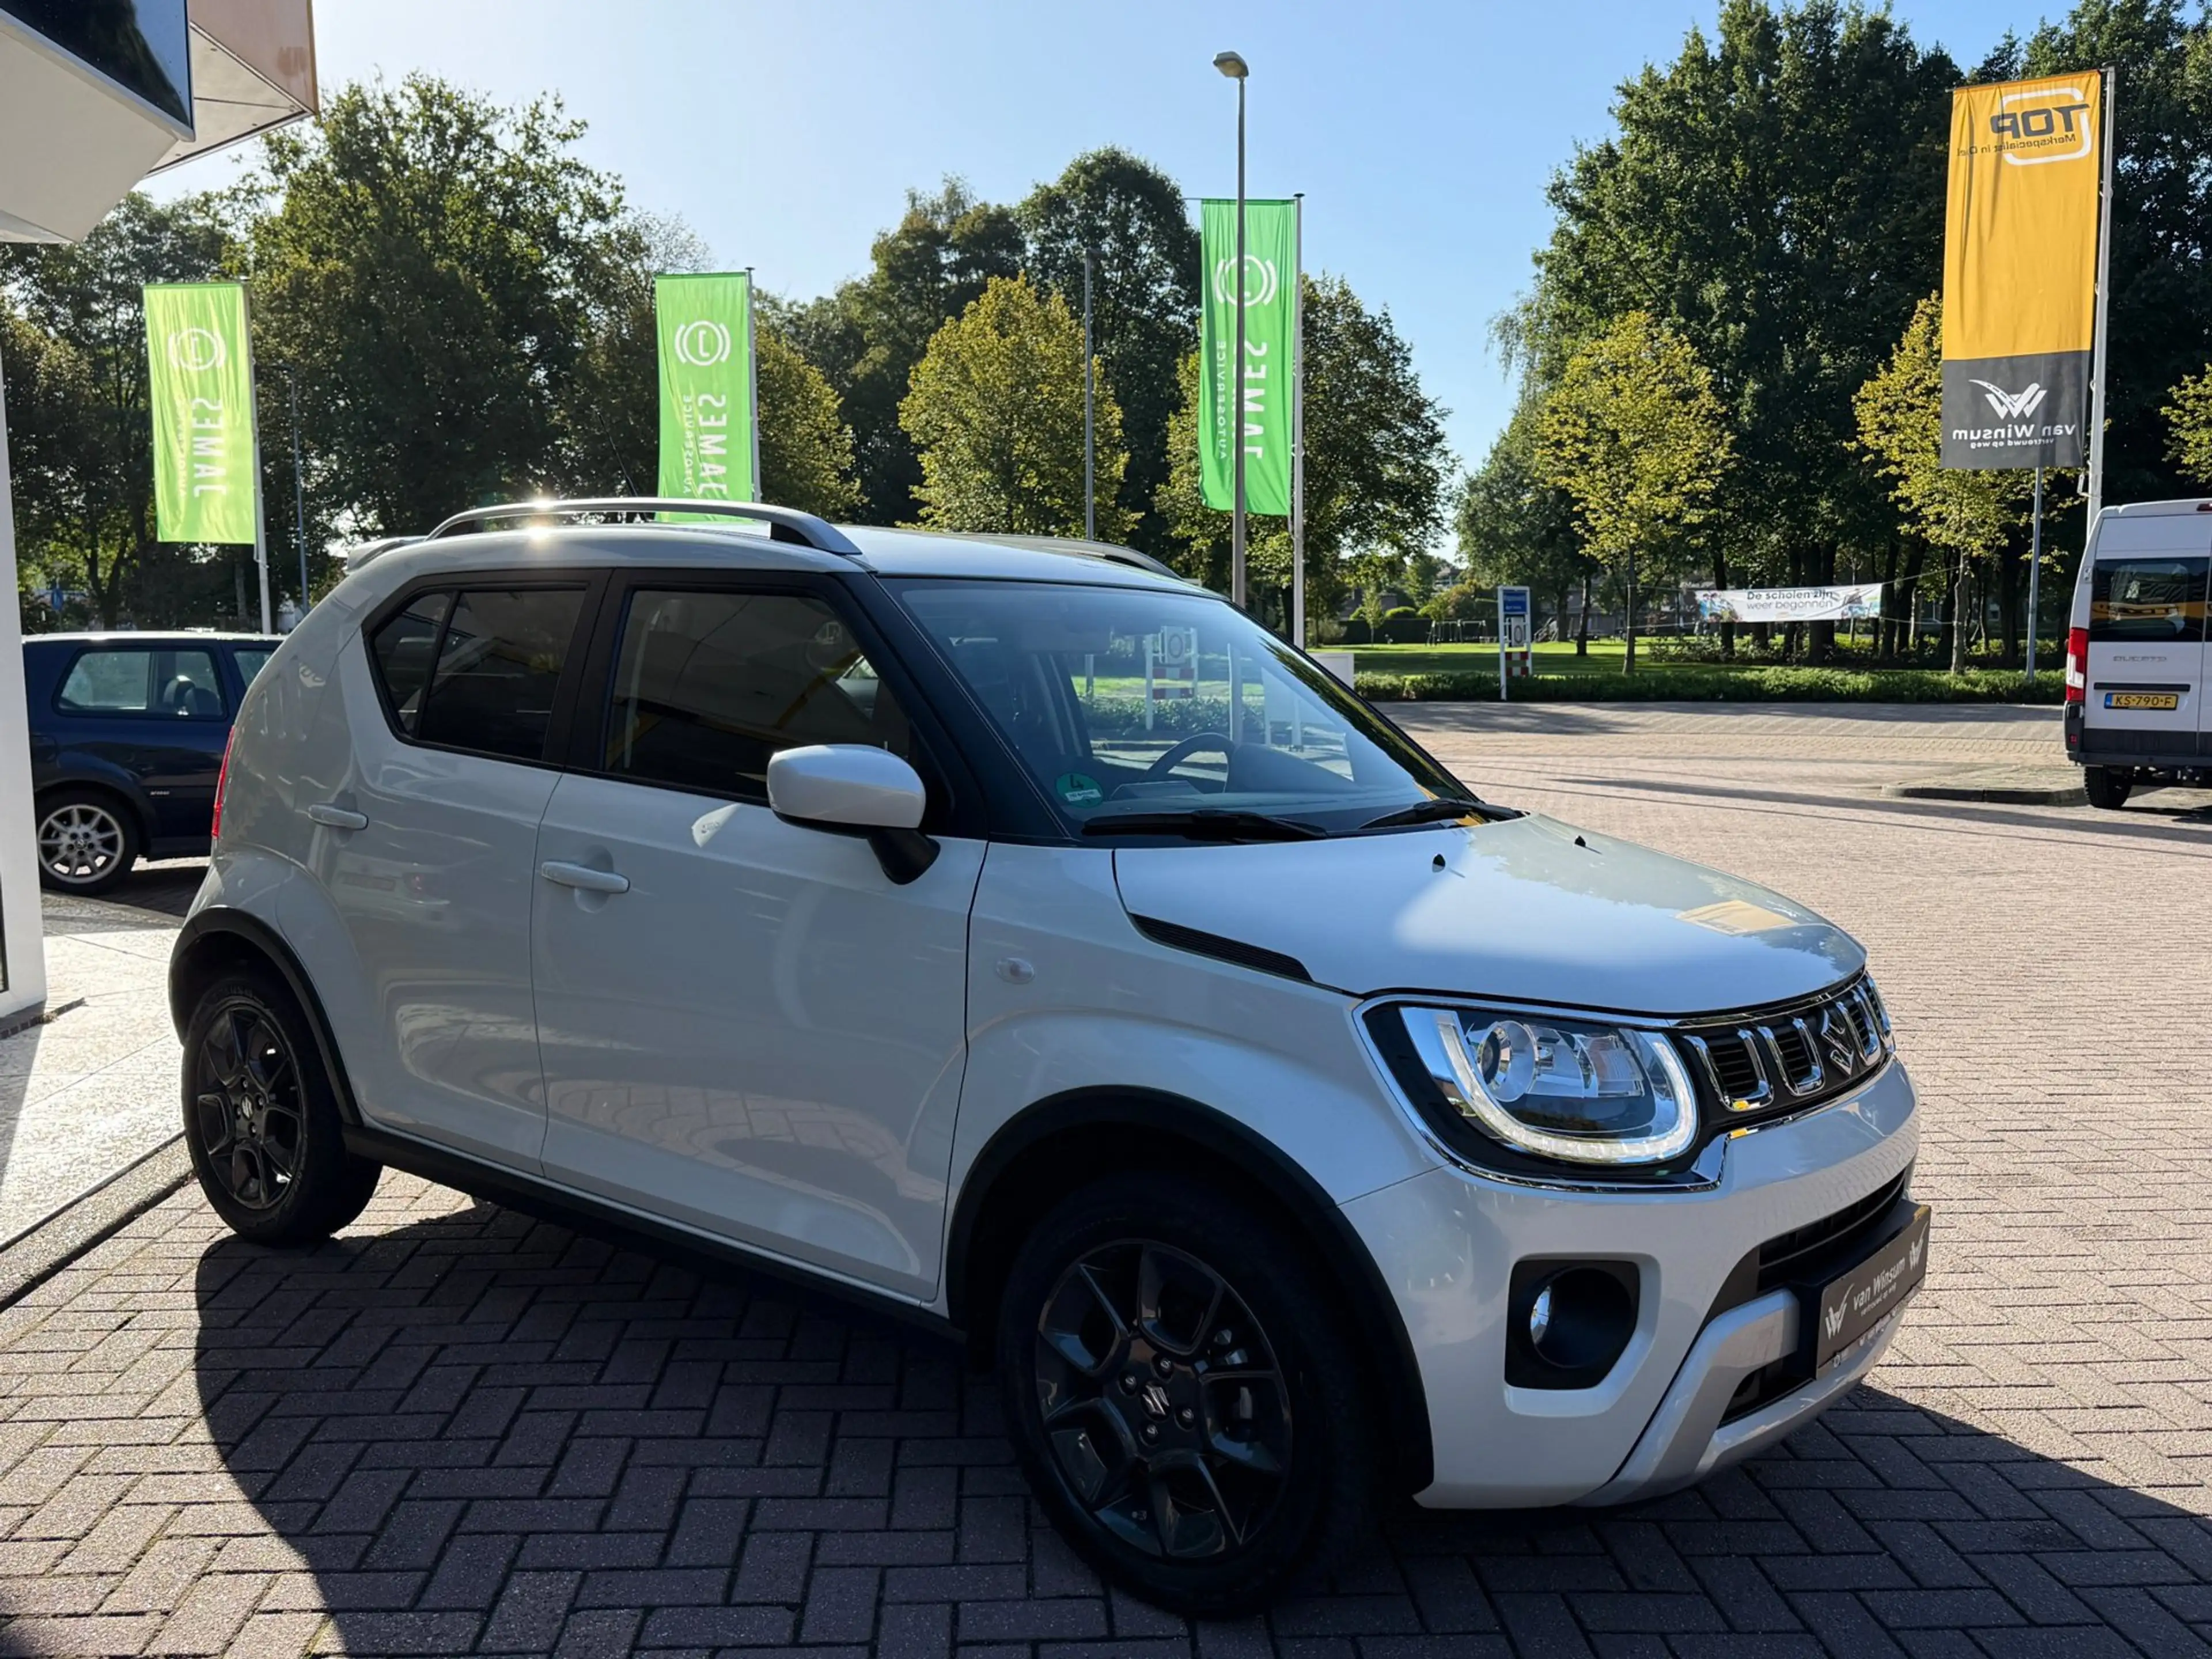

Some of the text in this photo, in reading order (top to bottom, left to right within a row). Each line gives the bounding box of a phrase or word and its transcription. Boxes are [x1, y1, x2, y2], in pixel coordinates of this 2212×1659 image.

[1747, 591, 1762, 600] De
[1766, 590, 1810, 600] scholen
[1775, 600, 1833, 611] begonnen
[1853, 1257, 1906, 1310] van Winsum
